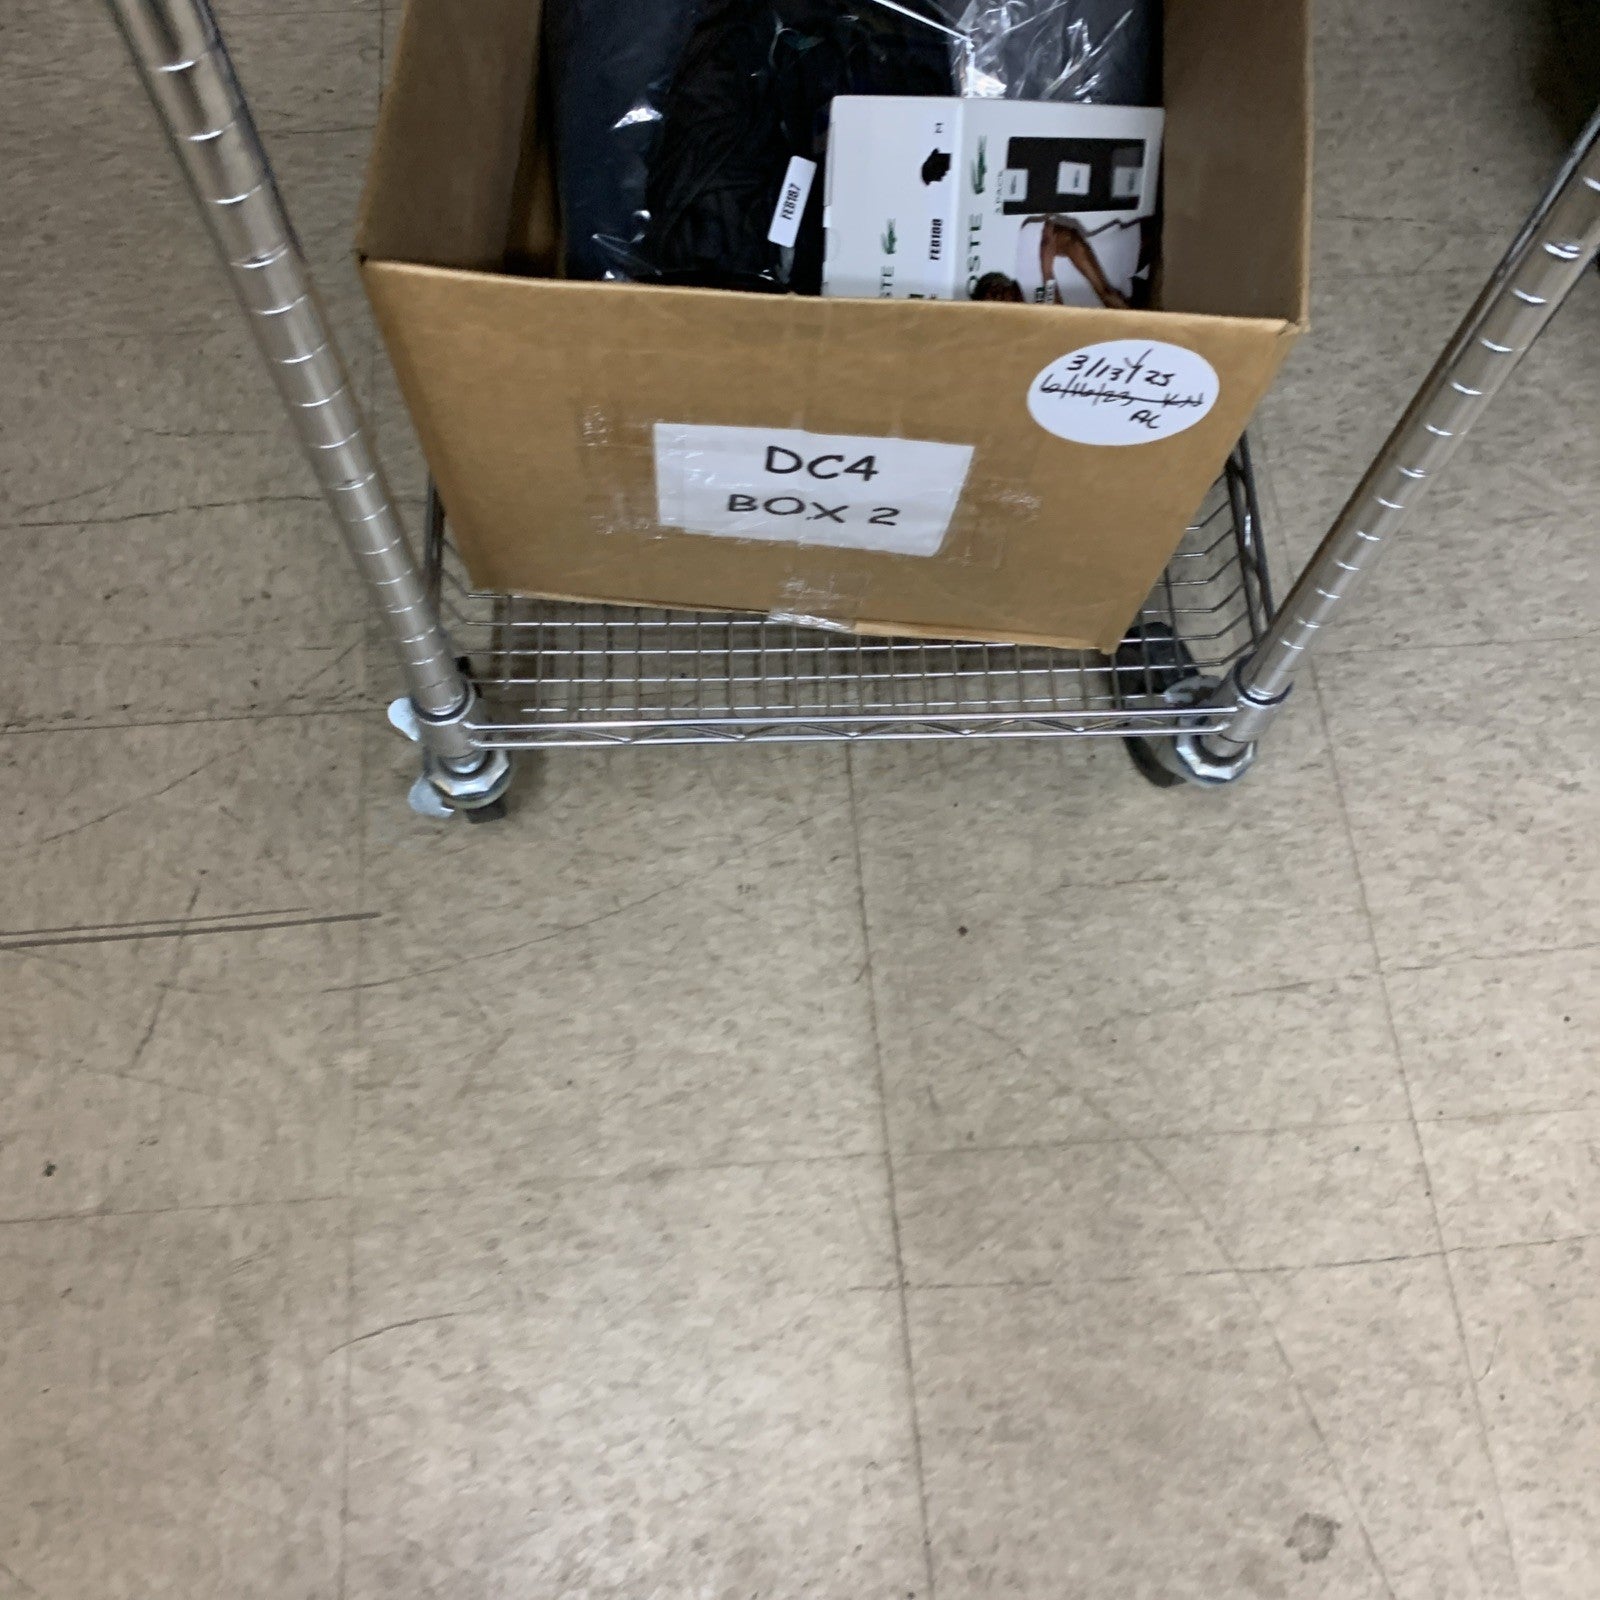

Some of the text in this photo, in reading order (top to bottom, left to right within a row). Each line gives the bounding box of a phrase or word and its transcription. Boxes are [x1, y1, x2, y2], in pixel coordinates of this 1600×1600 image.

[780, 183, 801, 220] FEB187
[764, 445, 879, 482] DC4
[726, 493, 900, 527] BOX 2
